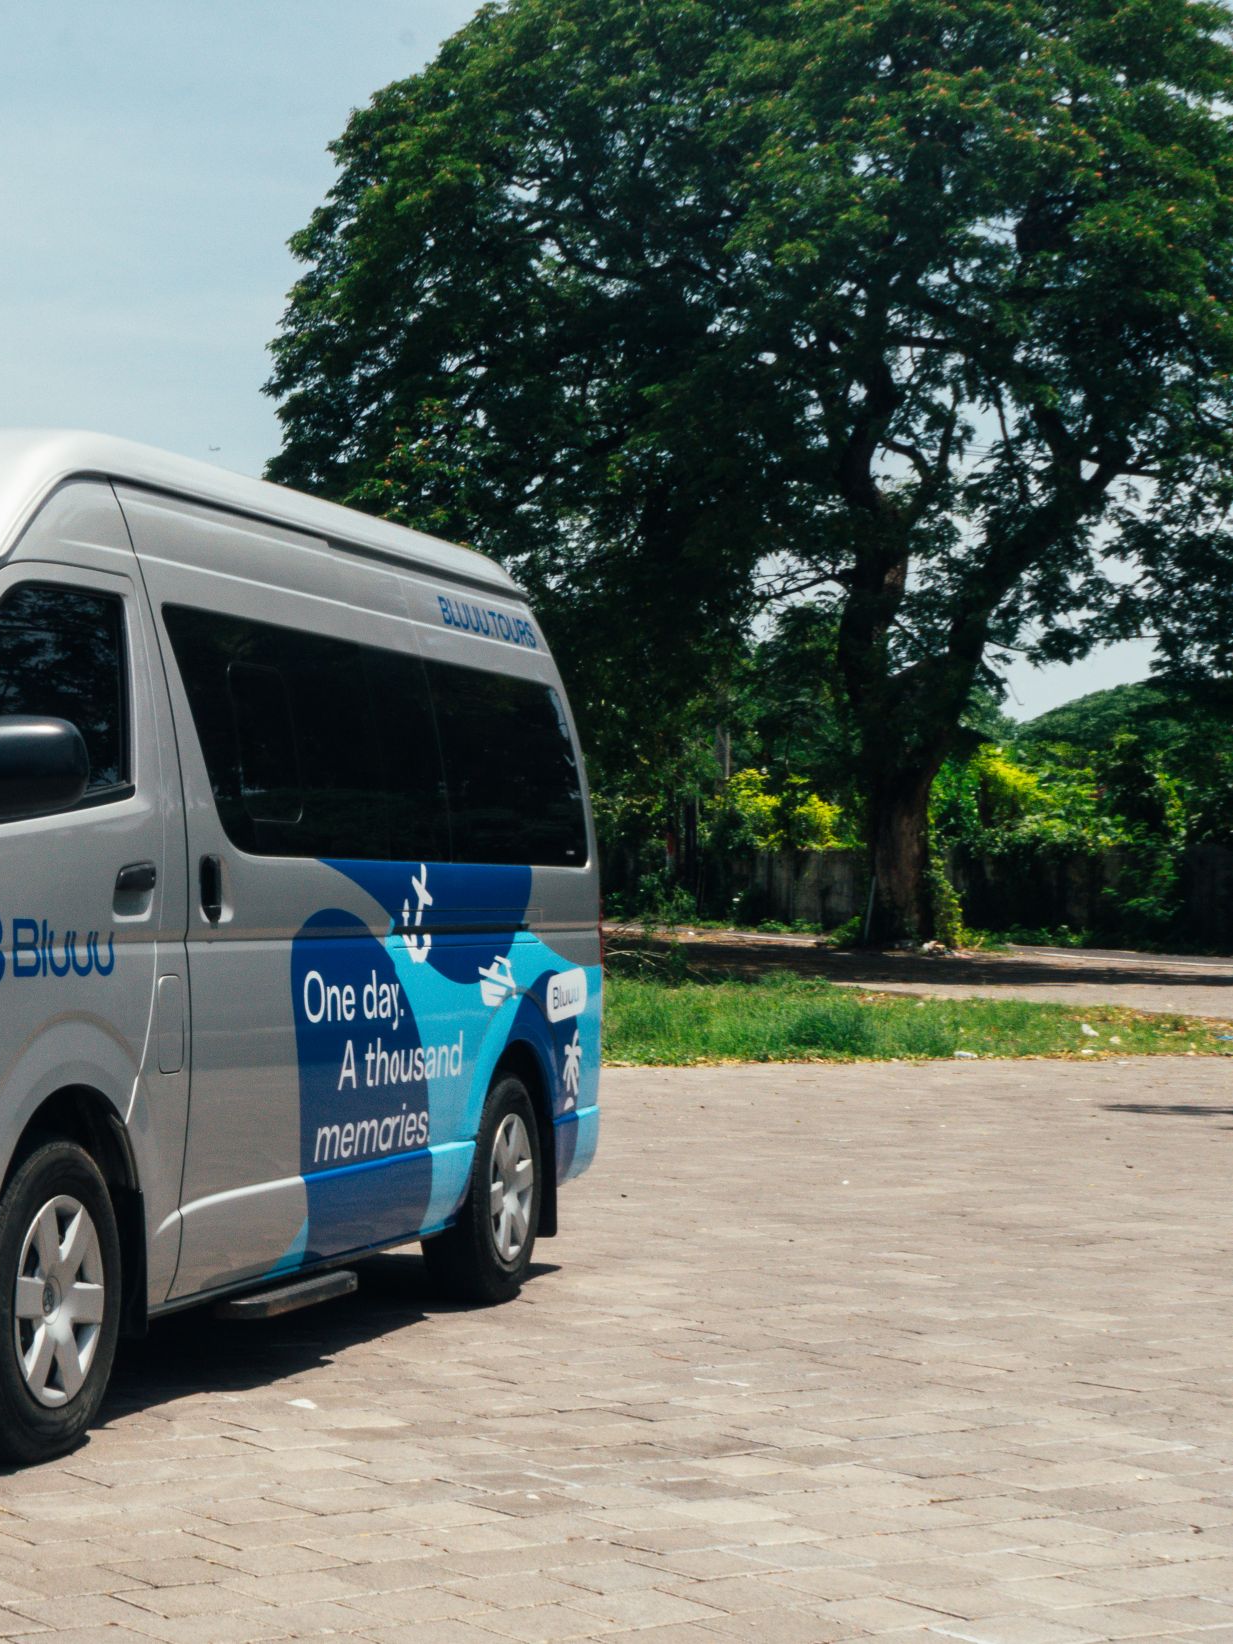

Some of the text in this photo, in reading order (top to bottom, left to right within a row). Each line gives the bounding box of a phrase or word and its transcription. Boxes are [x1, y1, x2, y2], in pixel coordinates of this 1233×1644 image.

[437, 595, 537, 649] BLUUU.TOURS
[12, 918, 115, 977] Bluuu
[303, 969, 404, 1031] One day.
[337, 1029, 464, 1091] A thousand
